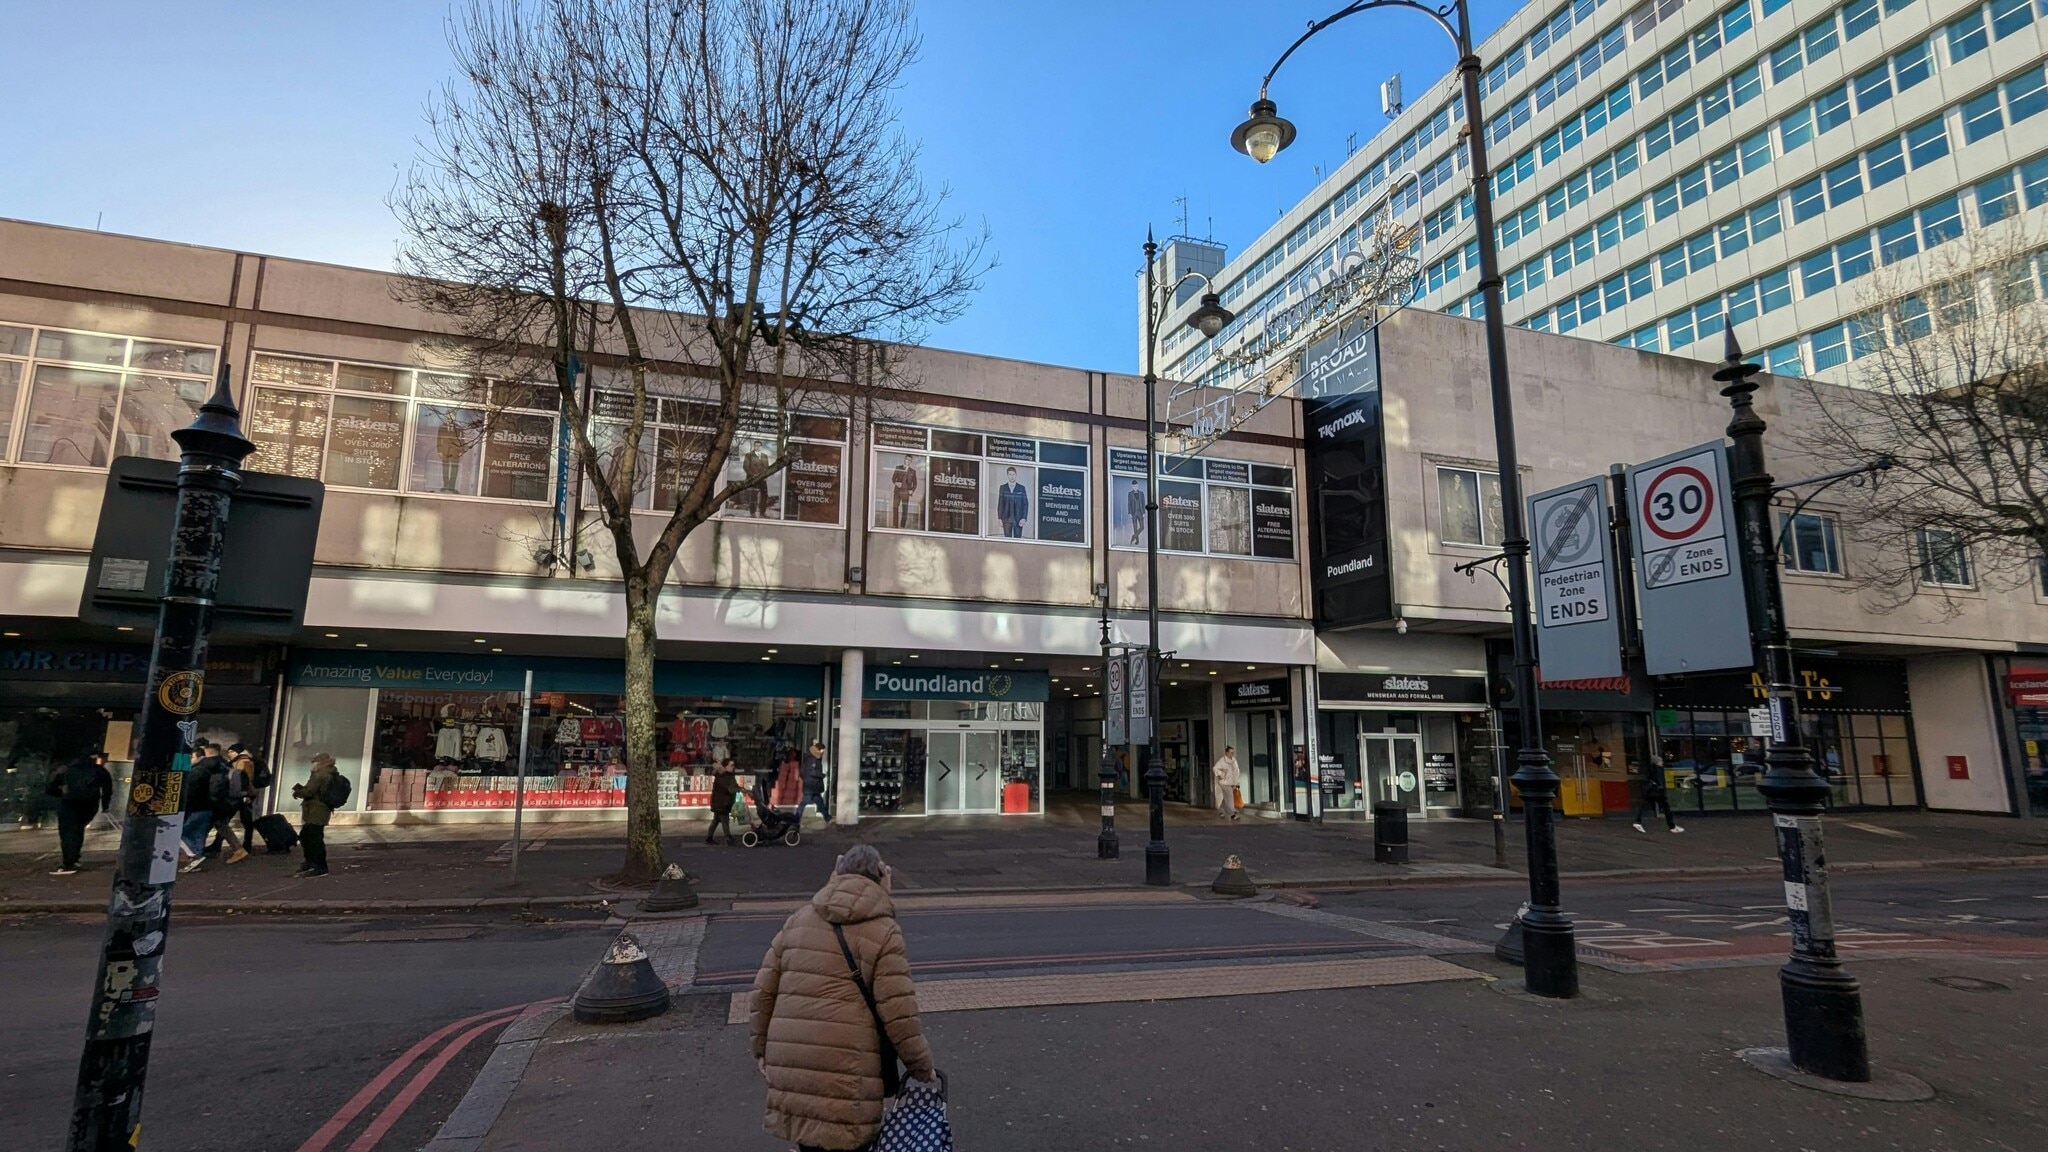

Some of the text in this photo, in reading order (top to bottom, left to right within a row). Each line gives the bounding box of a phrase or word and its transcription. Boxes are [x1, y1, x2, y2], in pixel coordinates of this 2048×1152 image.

[1310, 335, 1366, 380] BROAD
[1312, 376, 1327, 399] ST
[338, 416, 400, 432] slaters
[882, 426, 905, 434] Upstairs
[344, 439, 391, 449] OVER 3000
[493, 430, 549, 445] slaters
[993, 438, 1015, 446] Upstairs
[357, 458, 385, 466] STOCK
[1011, 453, 1033, 461] Reading
[492, 460, 546, 470] ALTERATIONS
[792, 460, 838, 474] slaters
[1212, 462, 1231, 470] Upstairs
[934, 472, 976, 486] slaters
[1042, 484, 1082, 497] slaters
[934, 499, 975, 508] ALTERATIONS
[1163, 495, 1199, 507] slaters
[1653, 485, 1702, 520] 30
[1256, 504, 1290, 516] slaters
[1257, 527, 1291, 535] ALTERATIONS
[1686, 548, 1713, 559] Zone
[1327, 554, 1372, 578] Poundland
[1680, 558, 1723, 576] ENDS
[1544, 569, 1600, 587] Pedestrian
[1560, 585, 1585, 597] Zone
[1550, 599, 1598, 620] ENDS
[303, 664, 494, 684] Amazing Value Everyday!
[875, 673, 983, 693] Poundland
[1238, 683, 1266, 696] slaters
[136, 785, 152, 798] BVB
